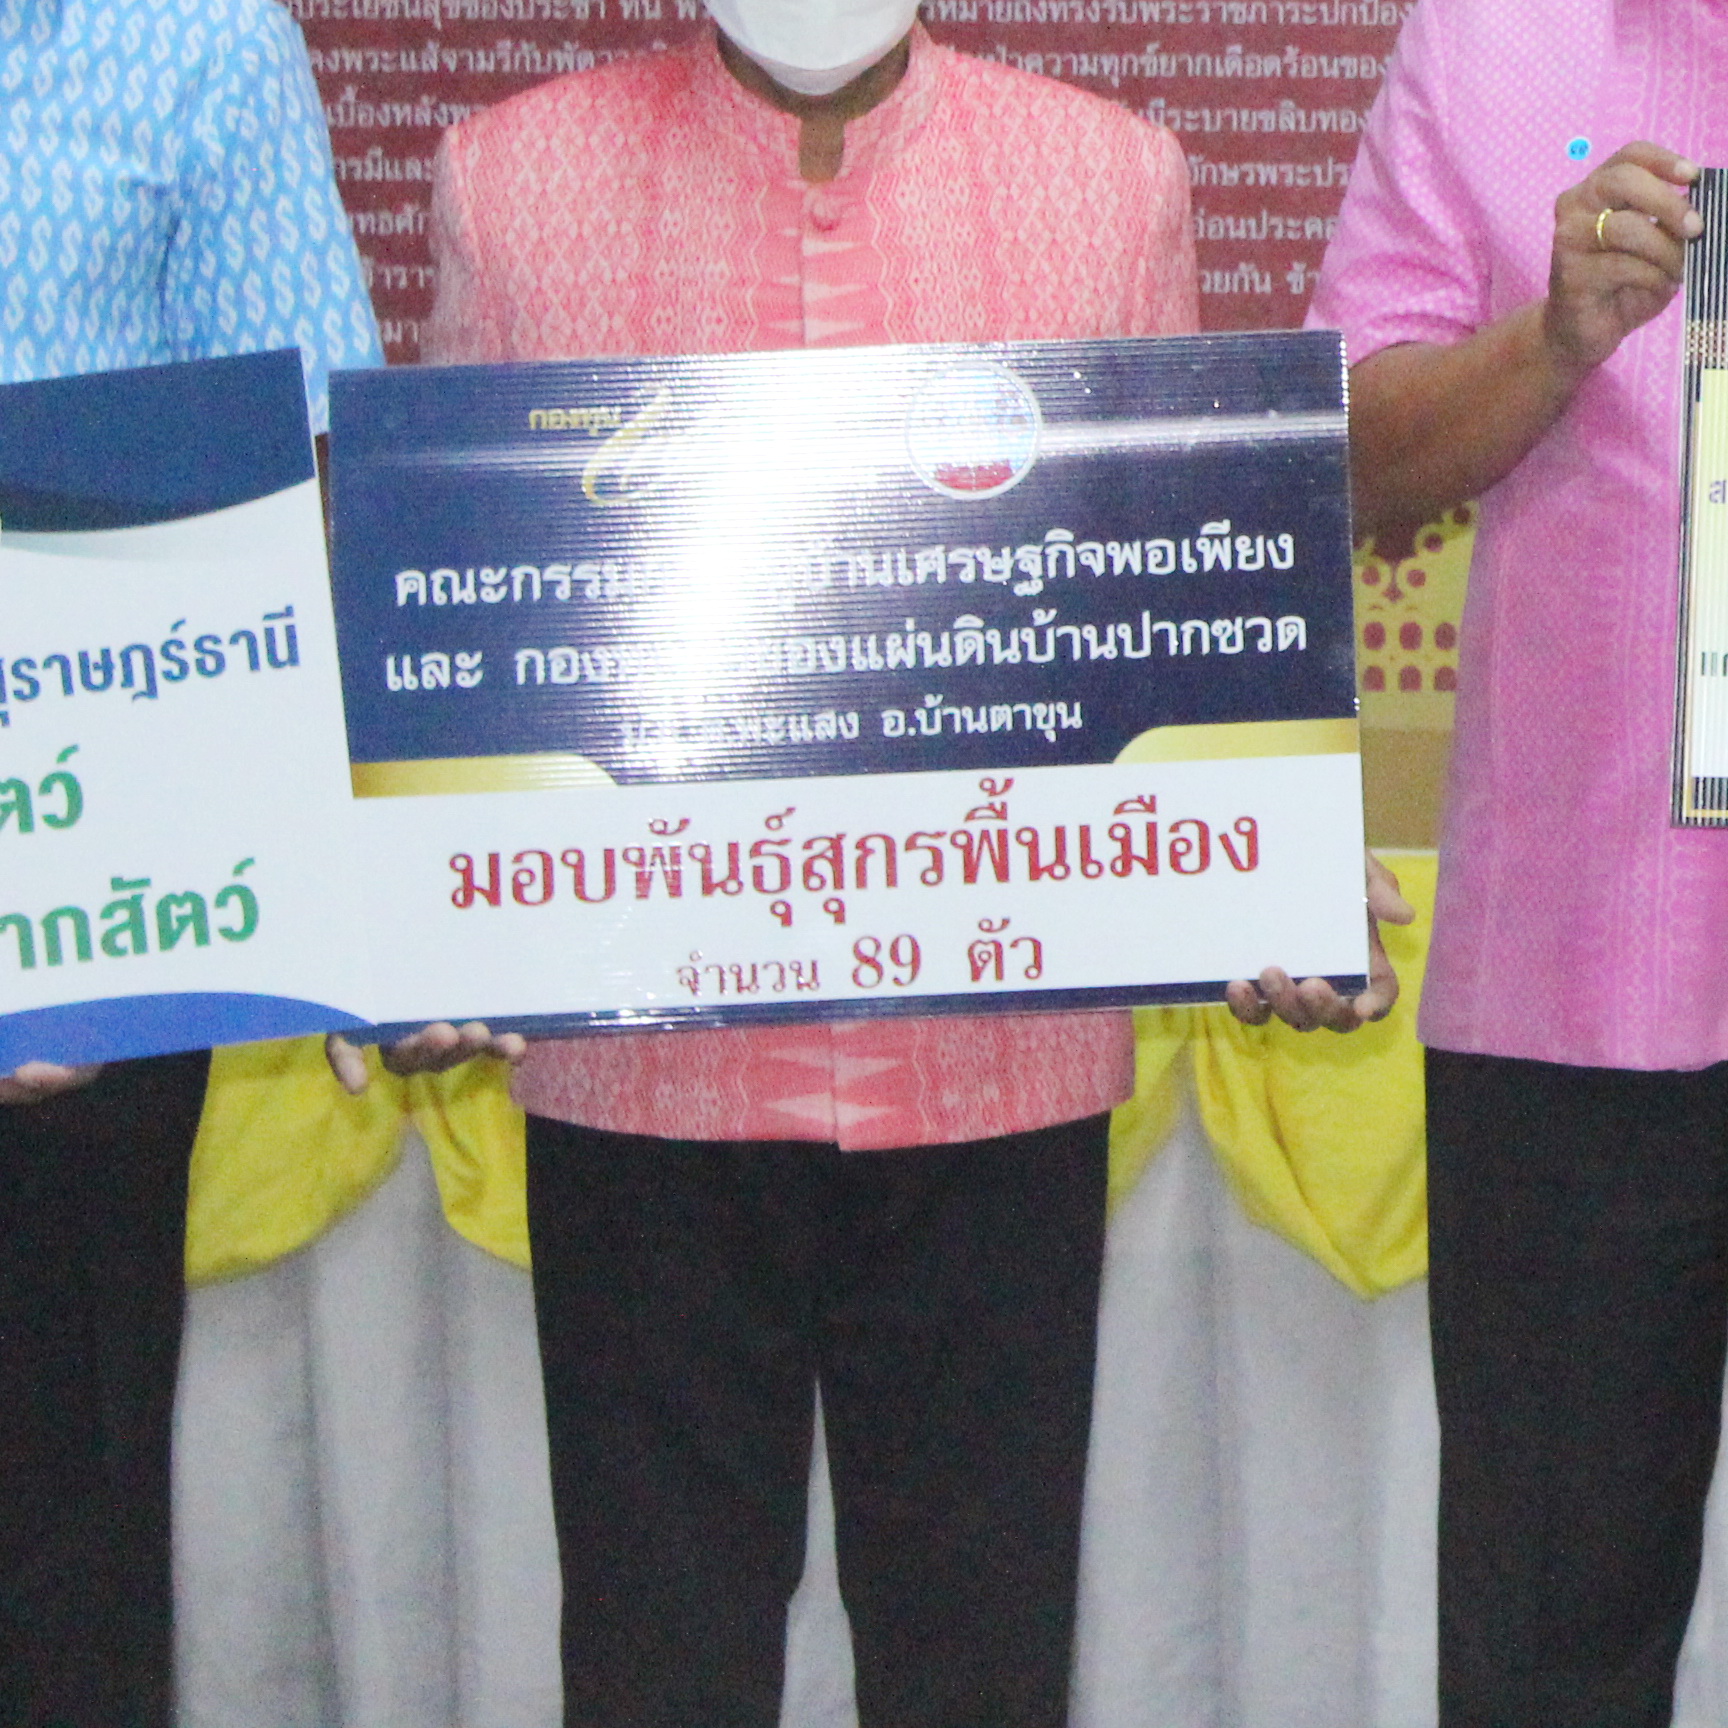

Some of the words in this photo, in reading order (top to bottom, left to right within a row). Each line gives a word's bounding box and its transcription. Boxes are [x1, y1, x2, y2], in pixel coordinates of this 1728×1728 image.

[0, 605, 300, 727] ุราษฎร์ธานี
[386, 643, 482, 692] และ
[881, 693, 1085, 740] อ.บ้านตาขุน
[450, 777, 1262, 927] มอบพันธุ์สุกรพื้นเมือง
[676, 954, 819, 1000] จำนวน
[850, 933, 925, 990] 89
[966, 916, 1045, 983] ตัว
